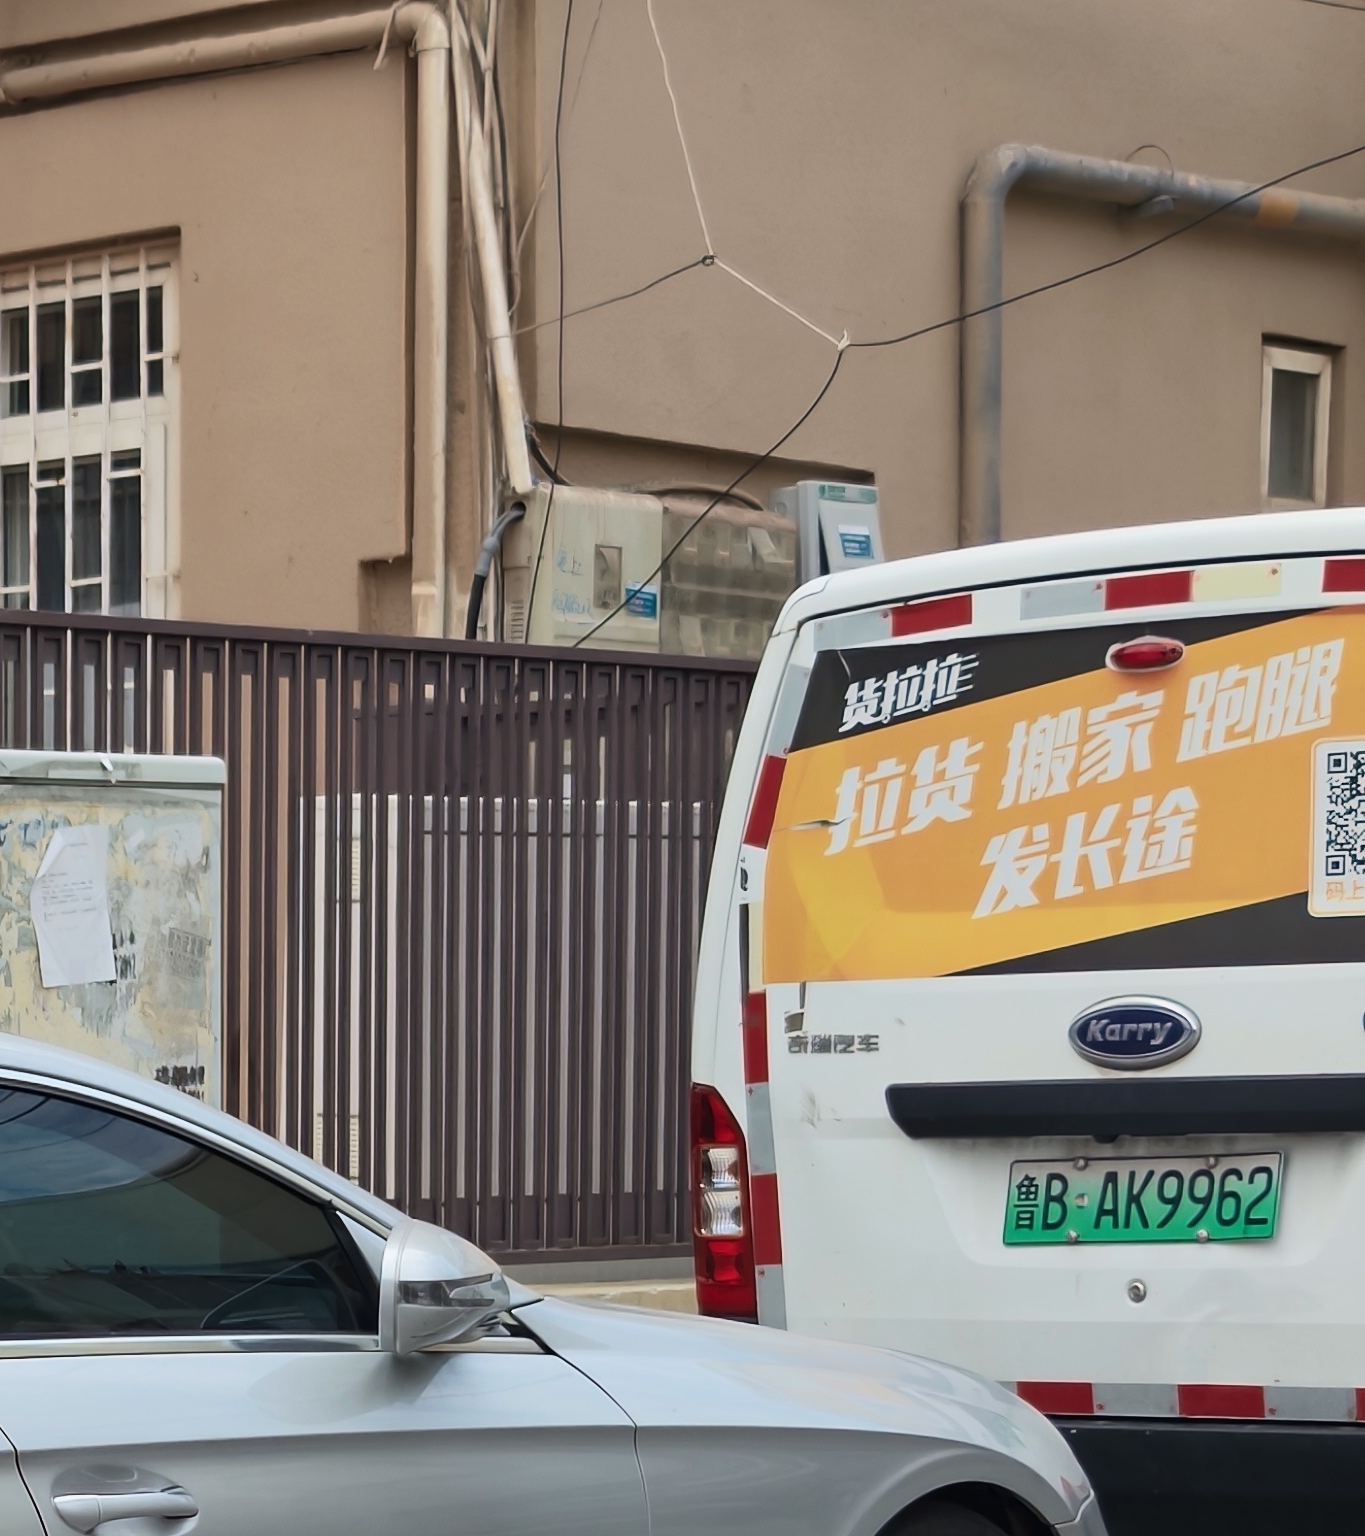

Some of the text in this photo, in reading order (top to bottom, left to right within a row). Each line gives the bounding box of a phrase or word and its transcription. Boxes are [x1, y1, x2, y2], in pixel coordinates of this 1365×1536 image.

[839, 653, 980, 732] 货拉拉
[824, 638, 1345, 856] 拉货 搬家 跑腿
[971, 786, 1199, 920] 发长途
[1086, 1018, 1173, 1046] Karry
